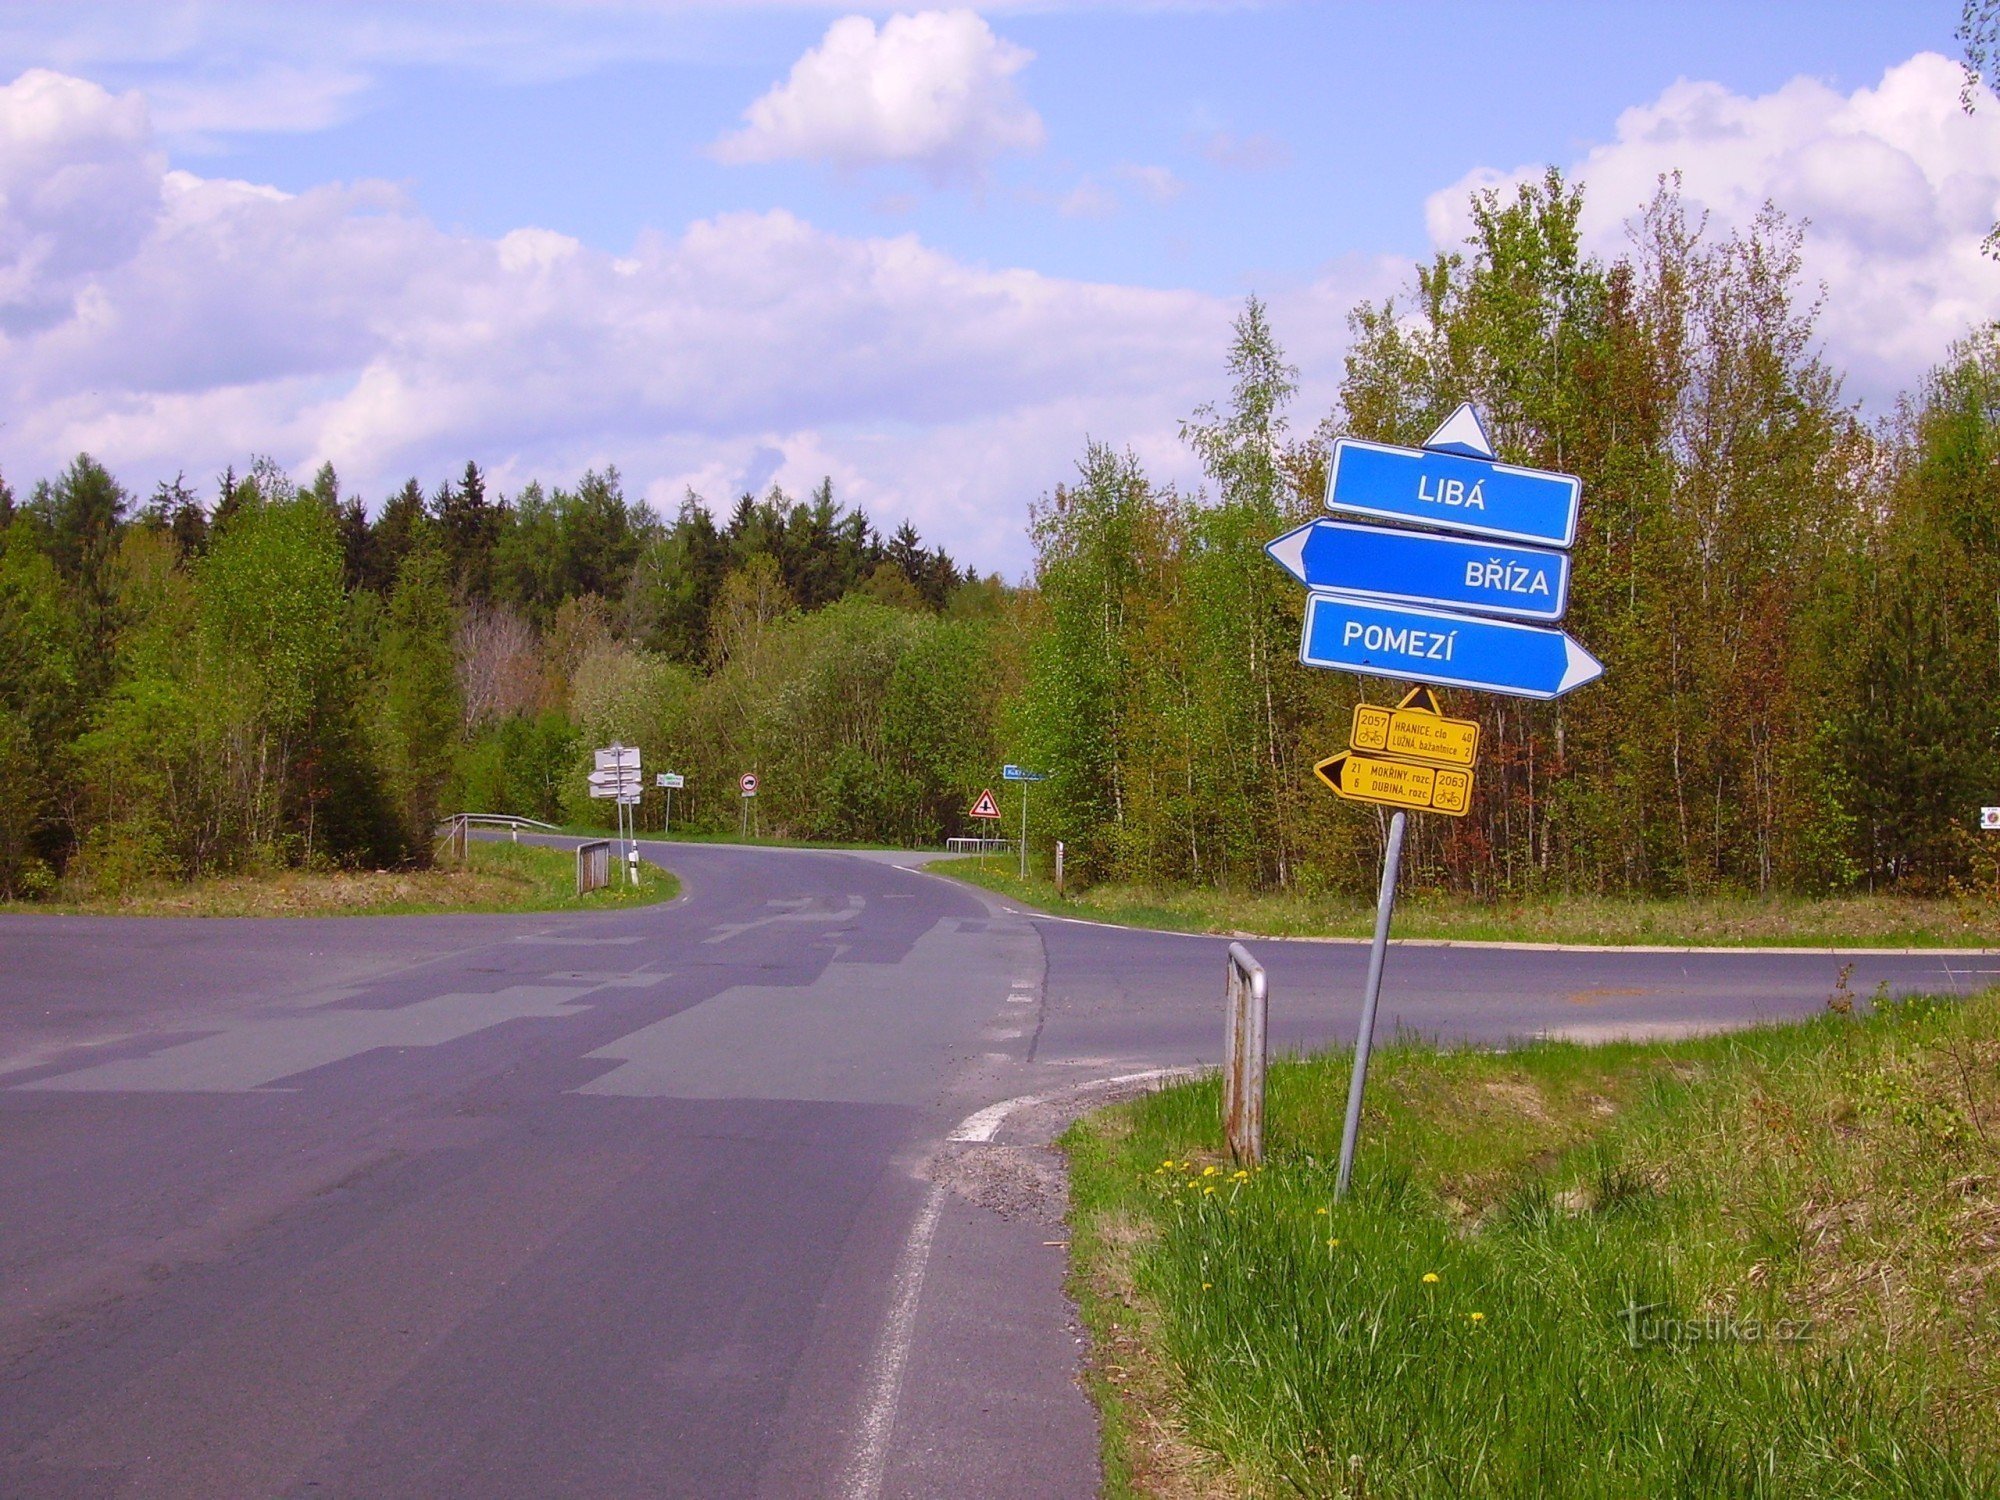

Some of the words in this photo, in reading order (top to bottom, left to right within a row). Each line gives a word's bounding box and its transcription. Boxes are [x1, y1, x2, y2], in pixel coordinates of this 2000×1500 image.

[1417, 474, 1486, 511] LIBÁ
[1464, 557, 1550, 596] BŘÍZA
[1342, 620, 1458, 662] POMEZÍ
[1360, 714, 1388, 728] 2057
[1434, 728, 1448, 739] clo
[1461, 732, 1473, 743] 40
[1464, 747, 1471, 758] 2
[1350, 762, 1362, 774] 21
[1353, 777, 1360, 788] 6
[1408, 788, 1429, 800] rozc.
[1438, 774, 1465, 788] 2063
